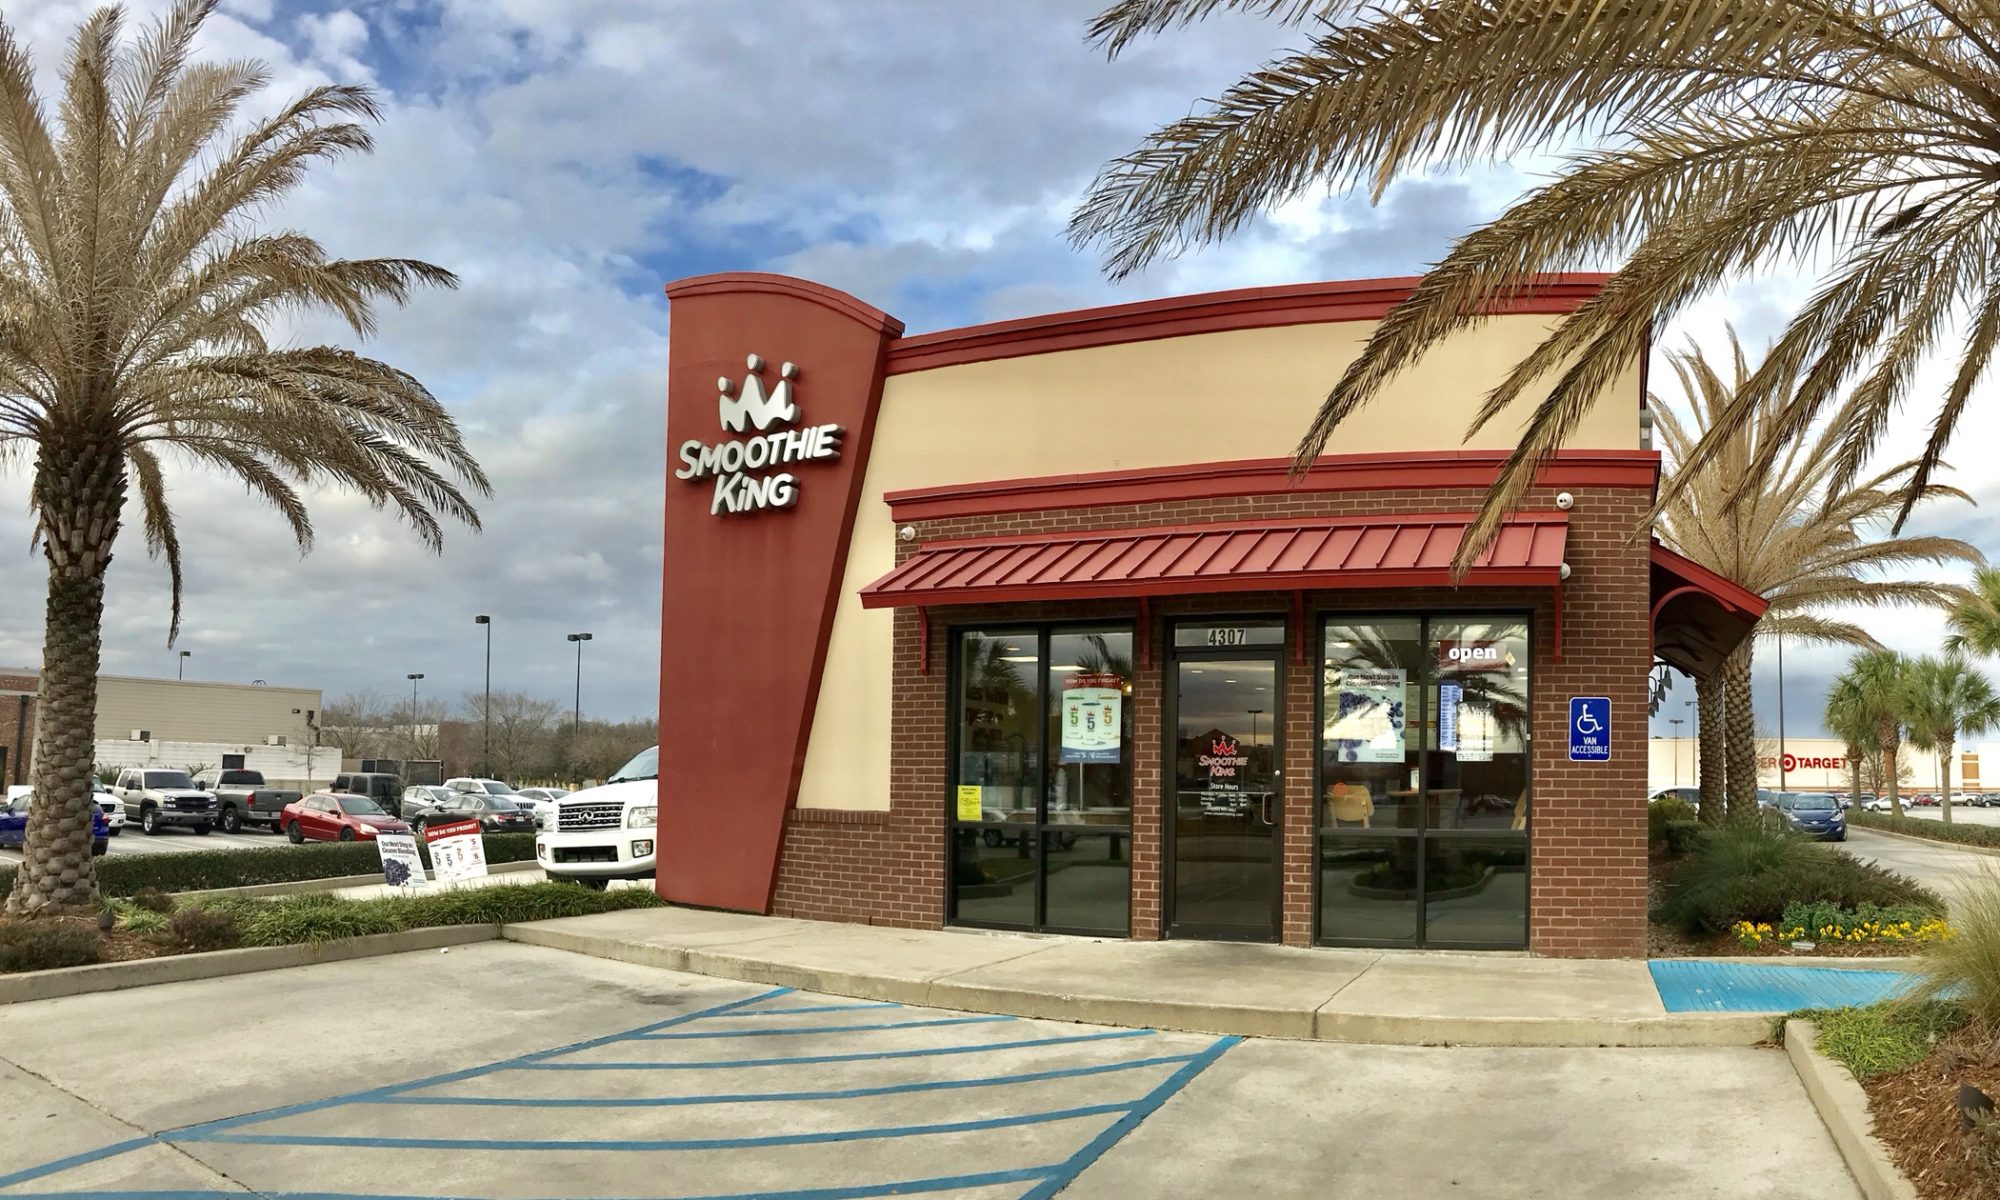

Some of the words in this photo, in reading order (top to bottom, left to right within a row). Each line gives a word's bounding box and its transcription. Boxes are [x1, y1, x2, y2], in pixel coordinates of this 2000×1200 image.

[675, 424, 846, 479] SMOOTHIE
[1209, 629, 1245, 646] 4307
[1448, 647, 1497, 663] open
[1583, 737, 1597, 745] VAN
[1571, 745, 1608, 755] ACCESSIBLE
[1199, 755, 1248, 767] SMOOTHIE
[1797, 757, 1847, 769] TARGET
[1210, 782, 1223, 790] Store
[1225, 783, 1239, 791] Hours
